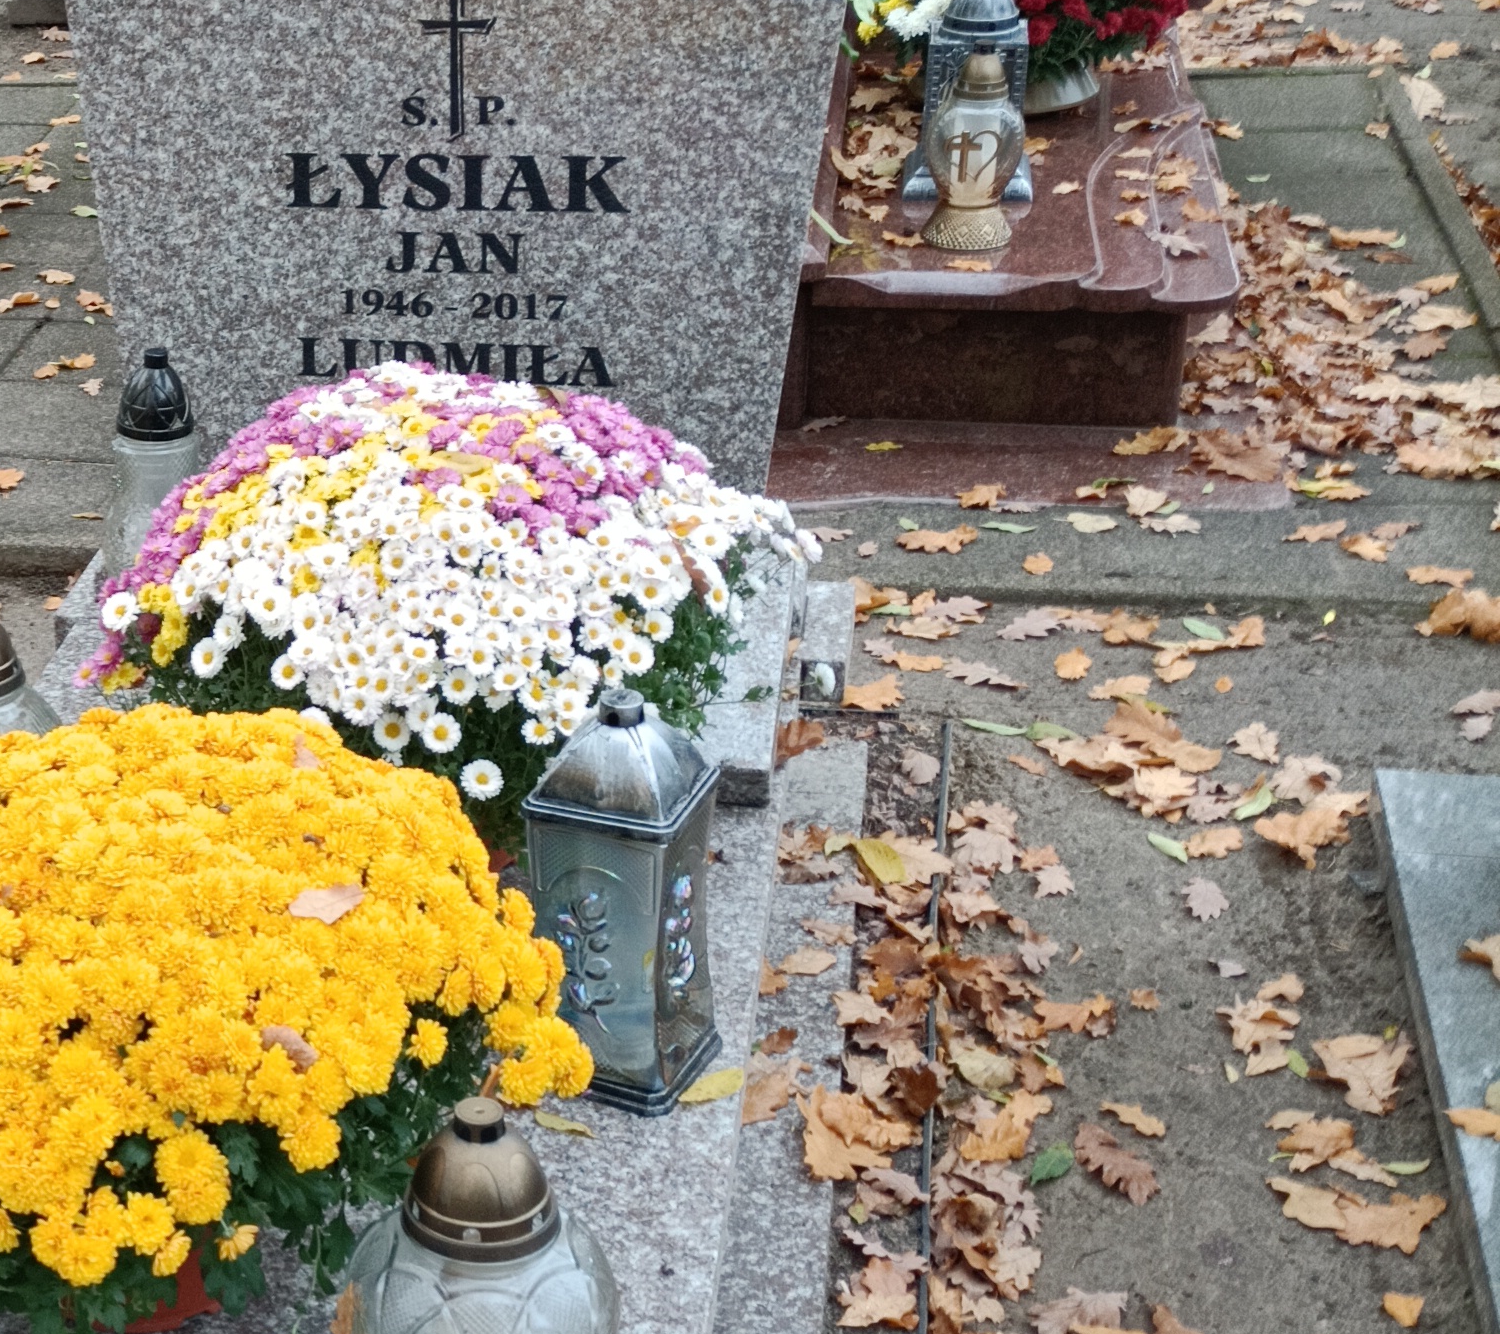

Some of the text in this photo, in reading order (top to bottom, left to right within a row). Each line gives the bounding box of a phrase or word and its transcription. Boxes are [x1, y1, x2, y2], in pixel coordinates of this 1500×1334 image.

[285, 152, 631, 213] ŁYSIAK
[386, 231, 525, 274] JAN
[340, 289, 434, 318] 1946
[470, 293, 569, 320] 2017
